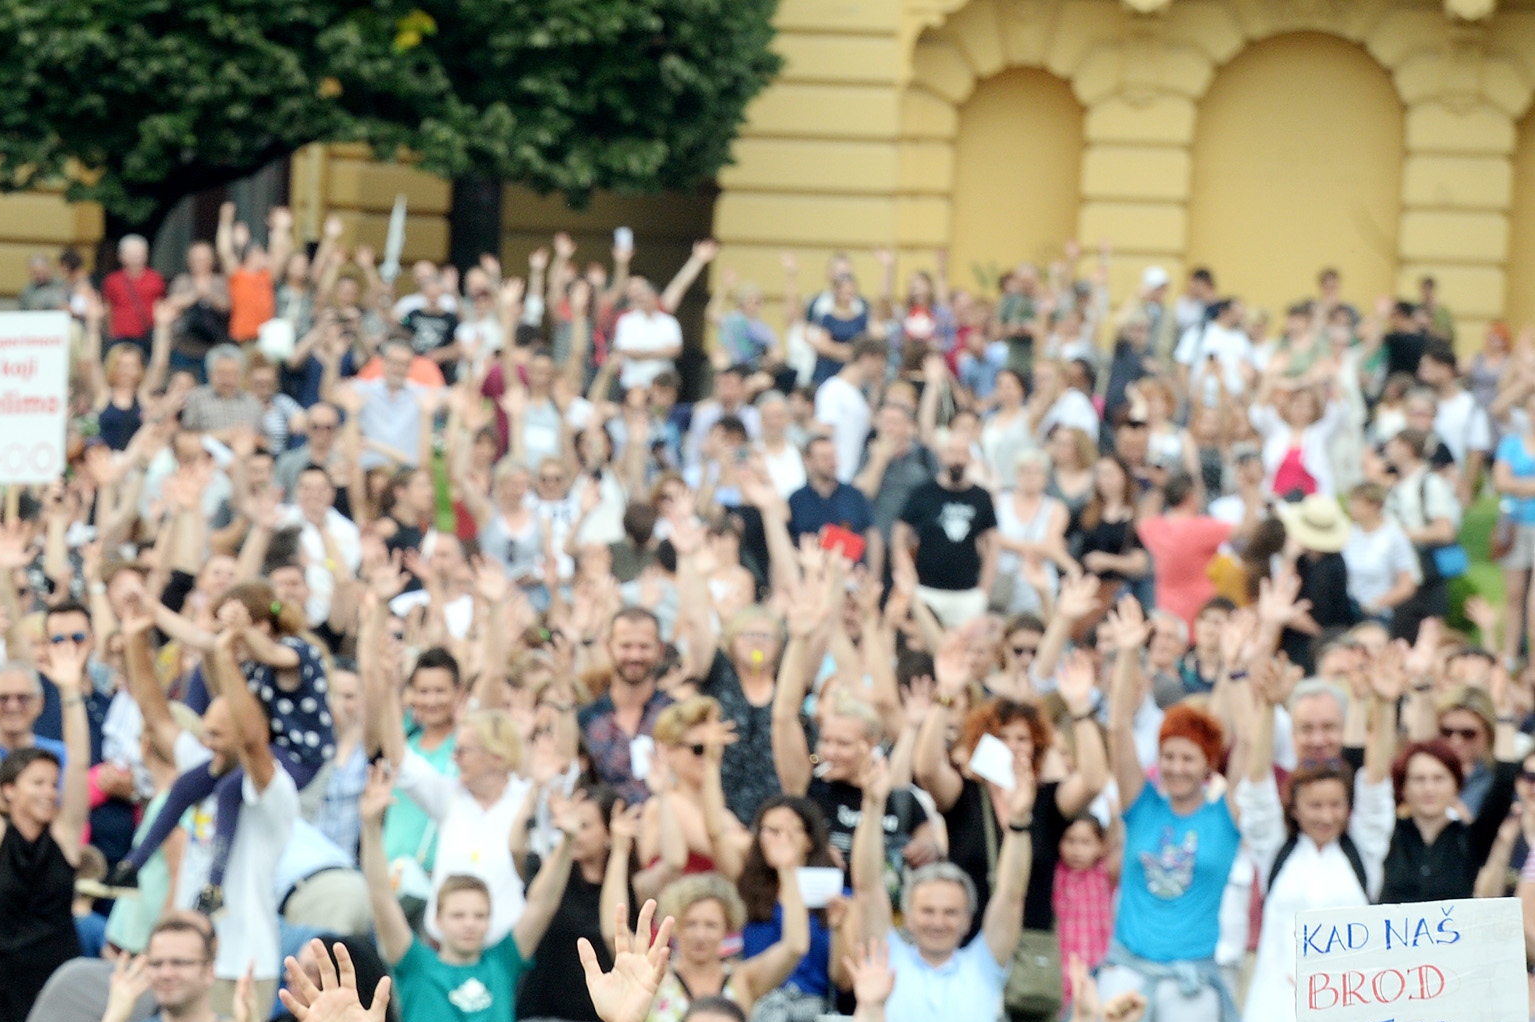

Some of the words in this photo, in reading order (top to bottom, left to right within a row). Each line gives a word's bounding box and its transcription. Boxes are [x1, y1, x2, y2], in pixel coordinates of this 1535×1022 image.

[1303, 922, 1369, 957] KAD
[1384, 905, 1461, 950] NAŠ
[1308, 965, 1445, 1010] BROD
